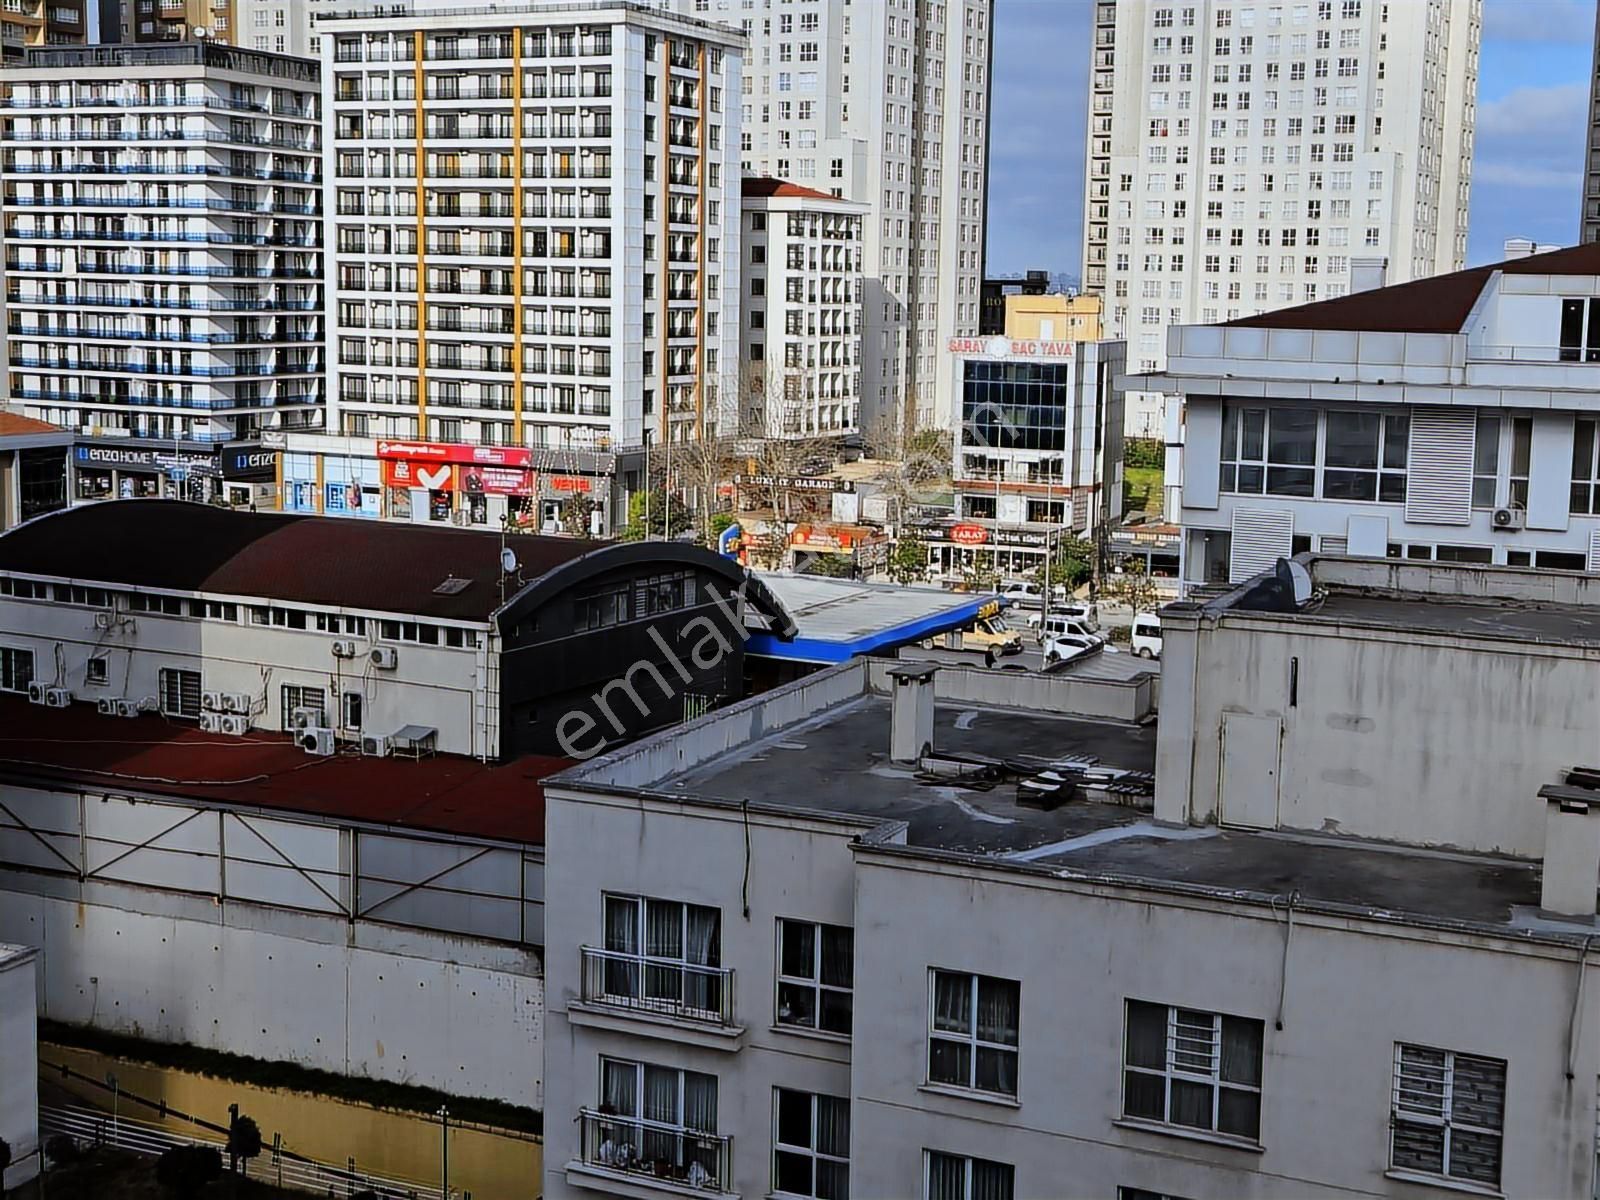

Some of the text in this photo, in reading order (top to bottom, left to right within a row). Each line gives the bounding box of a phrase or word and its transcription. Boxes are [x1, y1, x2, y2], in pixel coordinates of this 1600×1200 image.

[949, 338, 988, 353] SARAY
[1040, 341, 1073, 355] TAVA
[121, 450, 152, 465] HOME
[795, 478, 836, 490] GARAGE
